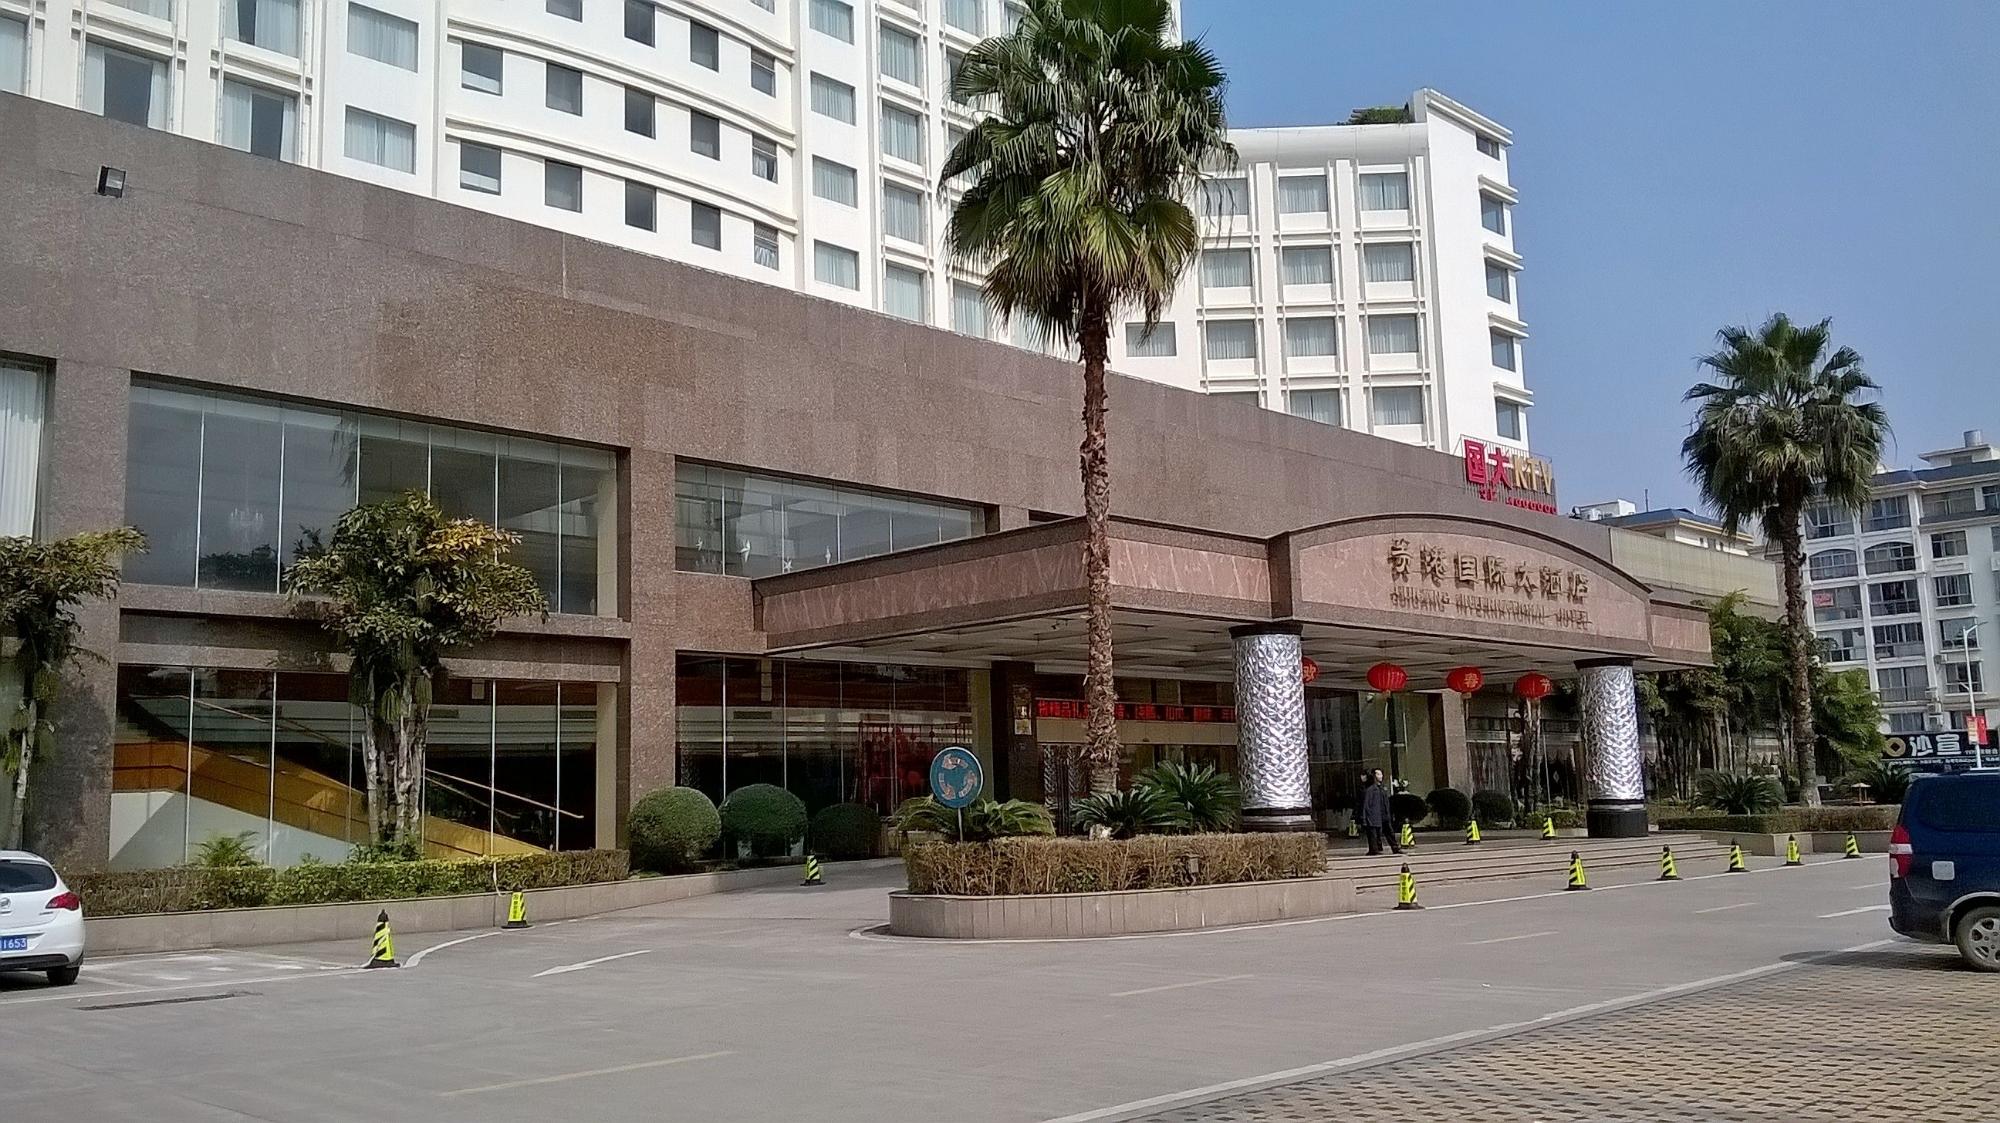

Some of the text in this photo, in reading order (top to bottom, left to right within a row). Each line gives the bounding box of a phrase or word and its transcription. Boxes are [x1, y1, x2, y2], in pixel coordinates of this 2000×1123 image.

[1390, 538, 1590, 601] 贵港国际大酒店
[1390, 586, 1589, 630] GUIGANG INTERNATIONAL HOTEL
[1908, 733, 1962, 757] 沙宣
